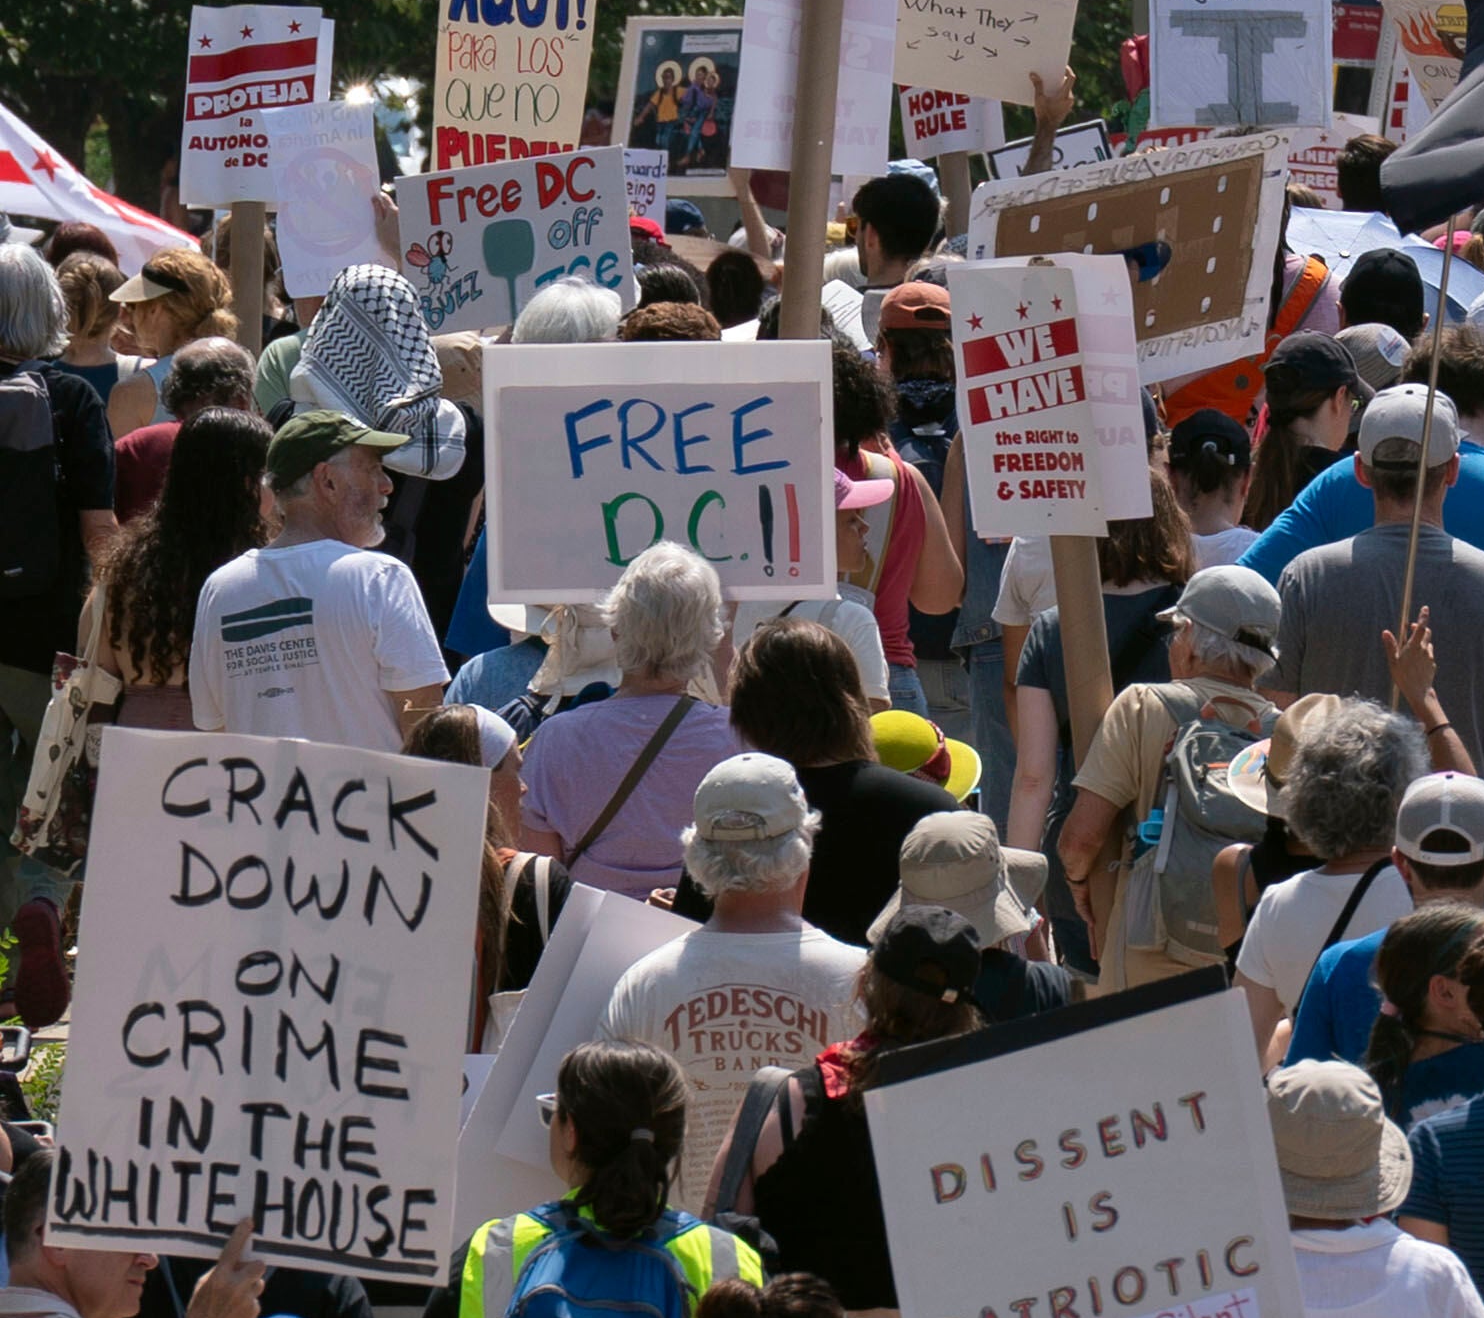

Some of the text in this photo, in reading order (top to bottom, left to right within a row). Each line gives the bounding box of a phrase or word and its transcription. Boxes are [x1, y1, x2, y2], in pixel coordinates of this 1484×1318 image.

[975, 7, 1015, 33] They
[517, 36, 564, 77] LOS
[193, 80, 311, 117] PROTEJA
[239, 116, 253, 128] la
[914, 110, 966, 141] RULE
[224, 152, 268, 168] de DC
[426, 176, 521, 225] Free
[994, 324, 1057, 368] WE
[983, 367, 1076, 420] HAVE
[564, 396, 791, 479] FREE
[995, 430, 1079, 446] the RIGHT to
[992, 452, 1085, 473] FREEDOM
[997, 479, 1086, 501] & SAFETY
[224, 642, 276, 660] THE DAVIS
[226, 654, 280, 671] FOR SOCIAL
[161, 757, 439, 862] CRACK
[170, 841, 433, 933] DOWN
[235, 948, 341, 1005] ON
[664, 988, 828, 1052] TEDESCHI
[122, 999, 409, 1101] CRIME
[688, 1031, 803, 1054] TRUCKS
[715, 1057, 780, 1071] BAND
[138, 1095, 381, 1178] IN THE
[929, 1091, 1207, 1204] DISSENT
[1062, 1190, 1119, 1242] IS
